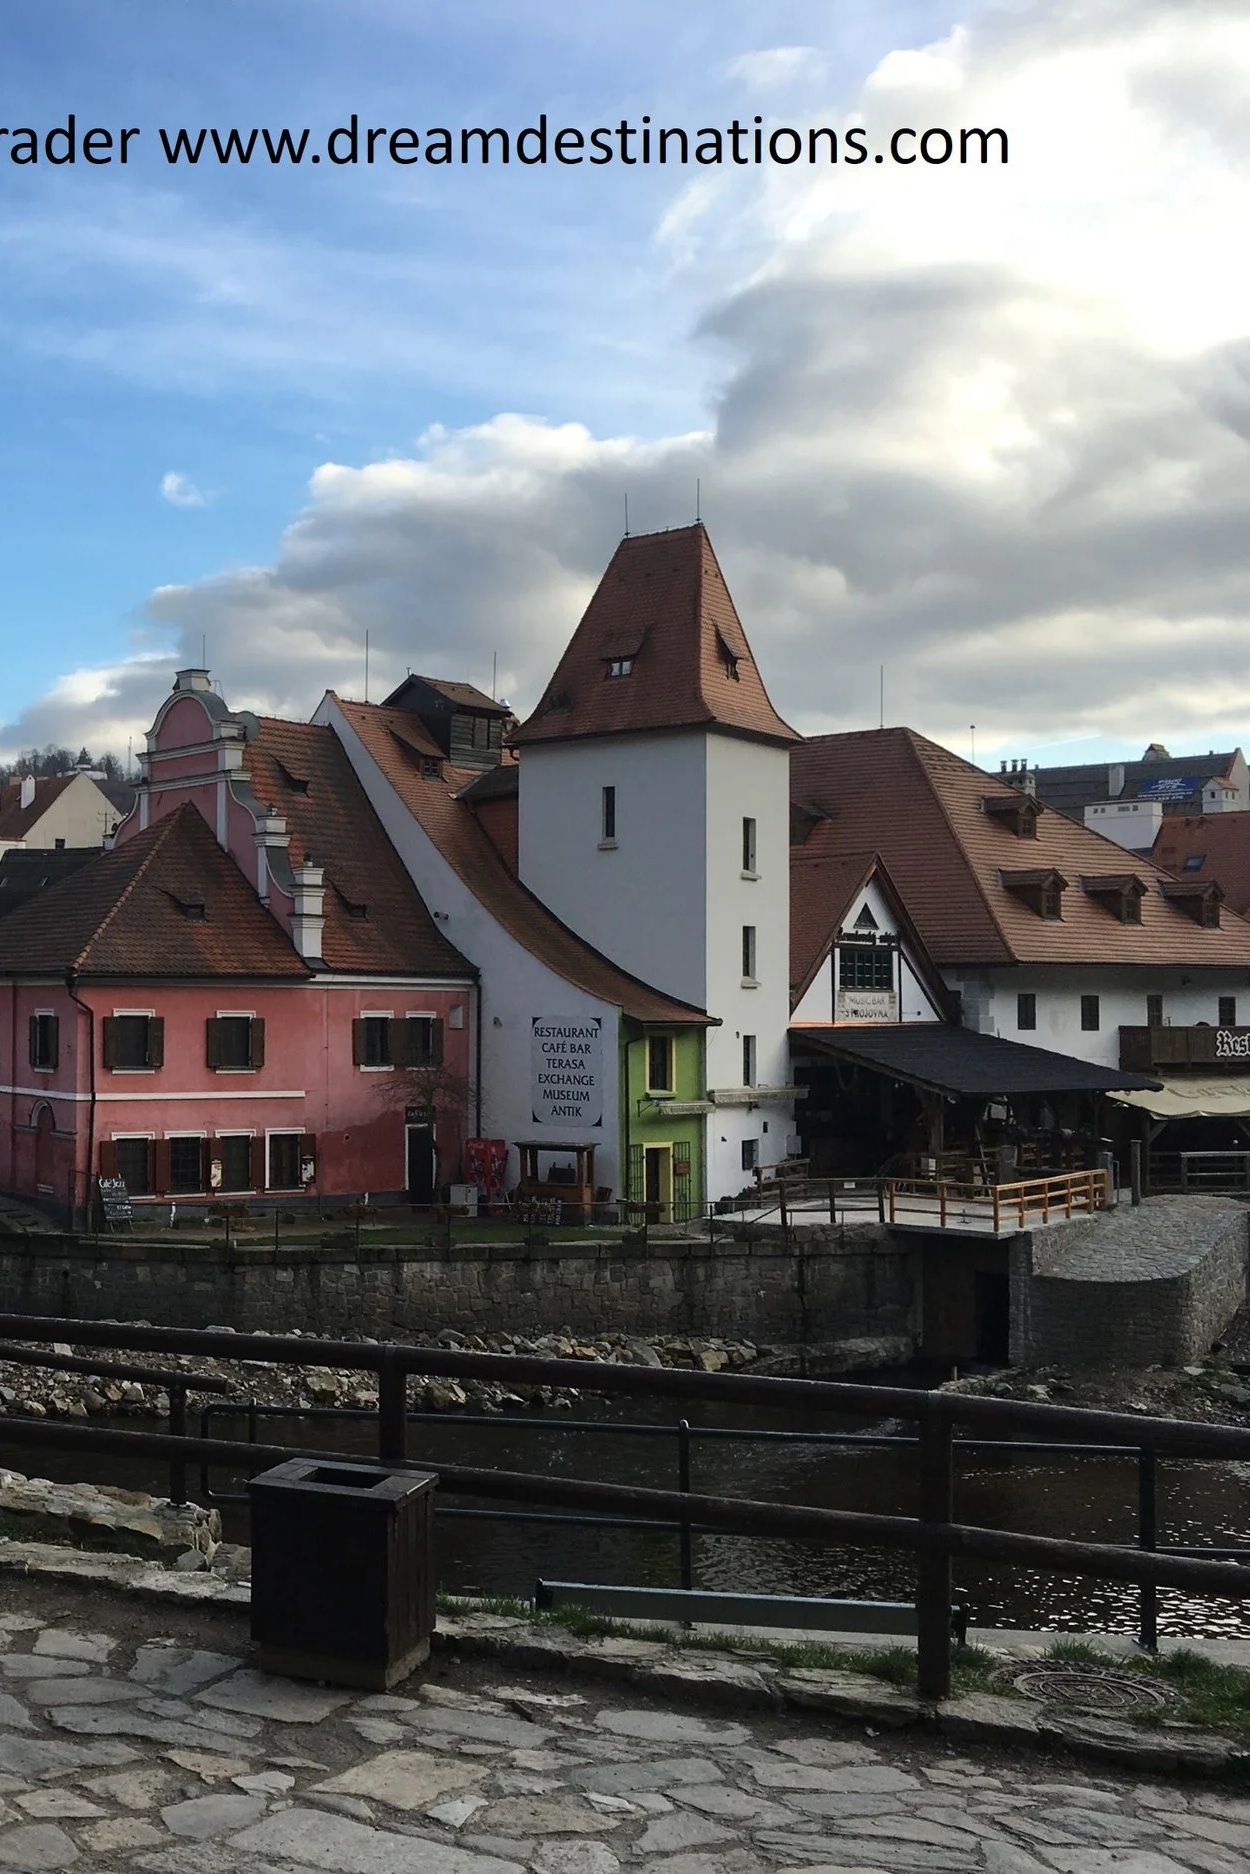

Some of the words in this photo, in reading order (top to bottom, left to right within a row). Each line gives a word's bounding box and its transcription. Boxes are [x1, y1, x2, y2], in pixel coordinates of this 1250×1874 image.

[534, 1027, 599, 1039] RESTAURANT
[541, 1041, 567, 1053] CAFÉ
[570, 1043, 592, 1054] BAR
[546, 1058, 586, 1070] TERASA
[538, 1073, 595, 1086] EXCHANGE
[542, 1089, 590, 1101] MUSEUM
[551, 1105, 582, 1117] ANTIK
